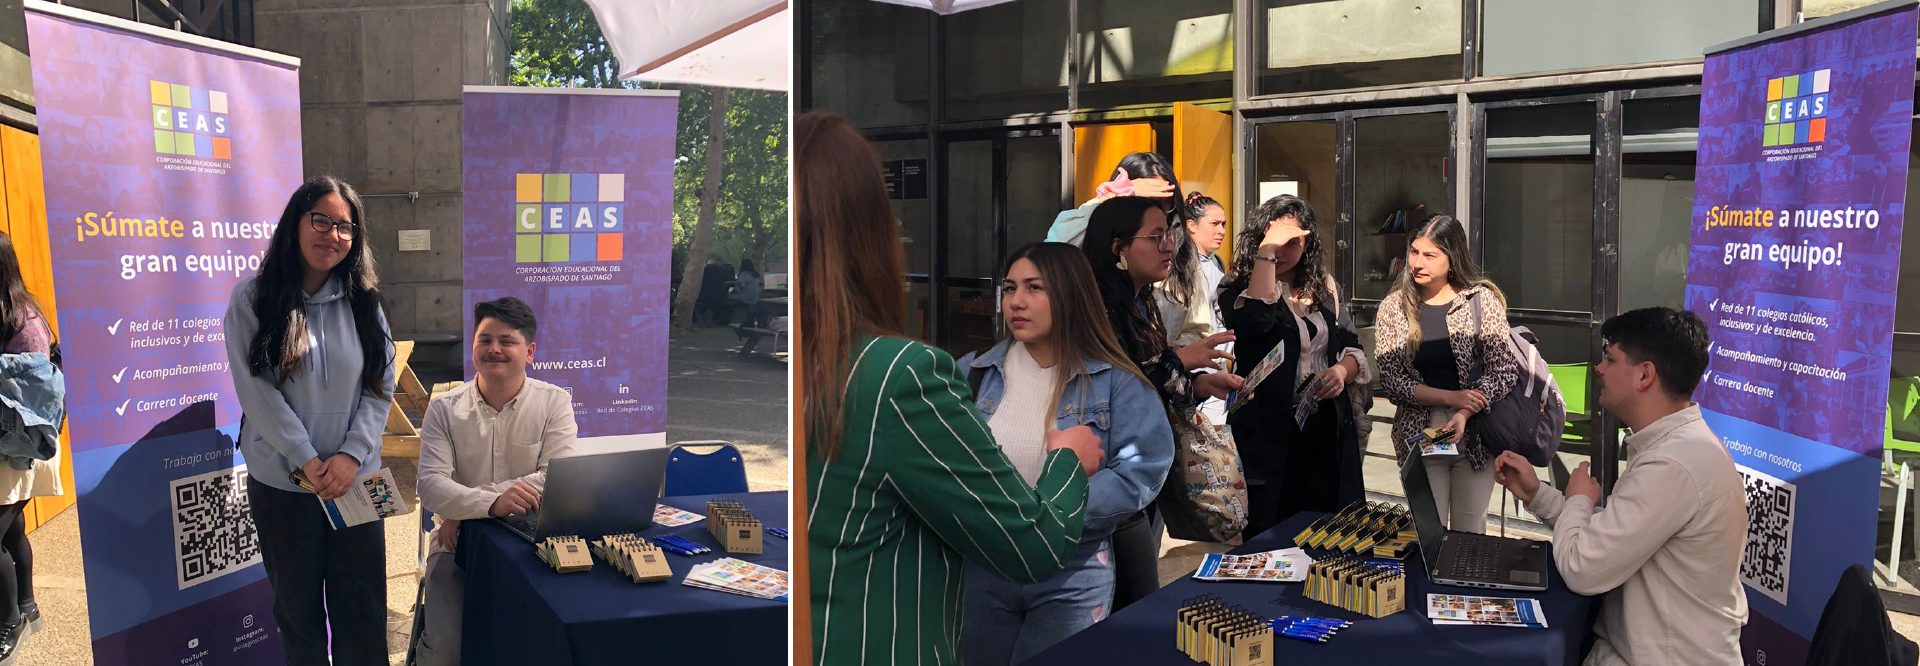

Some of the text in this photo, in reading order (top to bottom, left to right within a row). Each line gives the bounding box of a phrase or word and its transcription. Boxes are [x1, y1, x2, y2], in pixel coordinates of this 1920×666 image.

[1768, 97, 1824, 121] CEAS
[156, 109, 225, 134] CEAS
[156, 156, 192, 165] CORPORACIÓN
[193, 159, 222, 167] EDUCACIONAL
[164, 164, 197, 172] ARZOBISPADO
[204, 167, 226, 175] SANTIAGO
[76, 212, 279, 242] ¡Súmate a nuestr
[521, 207, 618, 229] CEAS
[1705, 204, 1880, 231] ¡Súmate a nuestro
[1723, 239, 1843, 271] gran equipo!
[120, 253, 177, 280] gran
[515, 265, 563, 274] CORPORACIÓN
[564, 265, 607, 273] EDUCACIONAL
[524, 274, 570, 283] ARZOBISPADO
[581, 273, 612, 281] SANTIAGO
[130, 316, 221, 332] Red de 11 colegios
[1721, 302, 1829, 328] Red de 11 colegios católicos,
[130, 335, 181, 348] inclusivos
[183, 336, 190, 346] y
[192, 331, 204, 343] de
[1719, 316, 1816, 342] inclusivos y de excelencia.
[133, 361, 230, 381] Acompañamiento y
[531, 356, 606, 370] www.ceas.cl
[1716, 345, 1847, 381] Acompañamiento y capacitación
[1714, 374, 1775, 398] Carrera docente
[136, 391, 219, 412] Carrera docente
[617, 405, 639, 413] Colegios
[164, 451, 202, 469] Trabaja
[204, 448, 222, 461] con
[1723, 436, 1802, 473] Trabaja con nosotros
[181, 649, 209, 665] YouTube:
